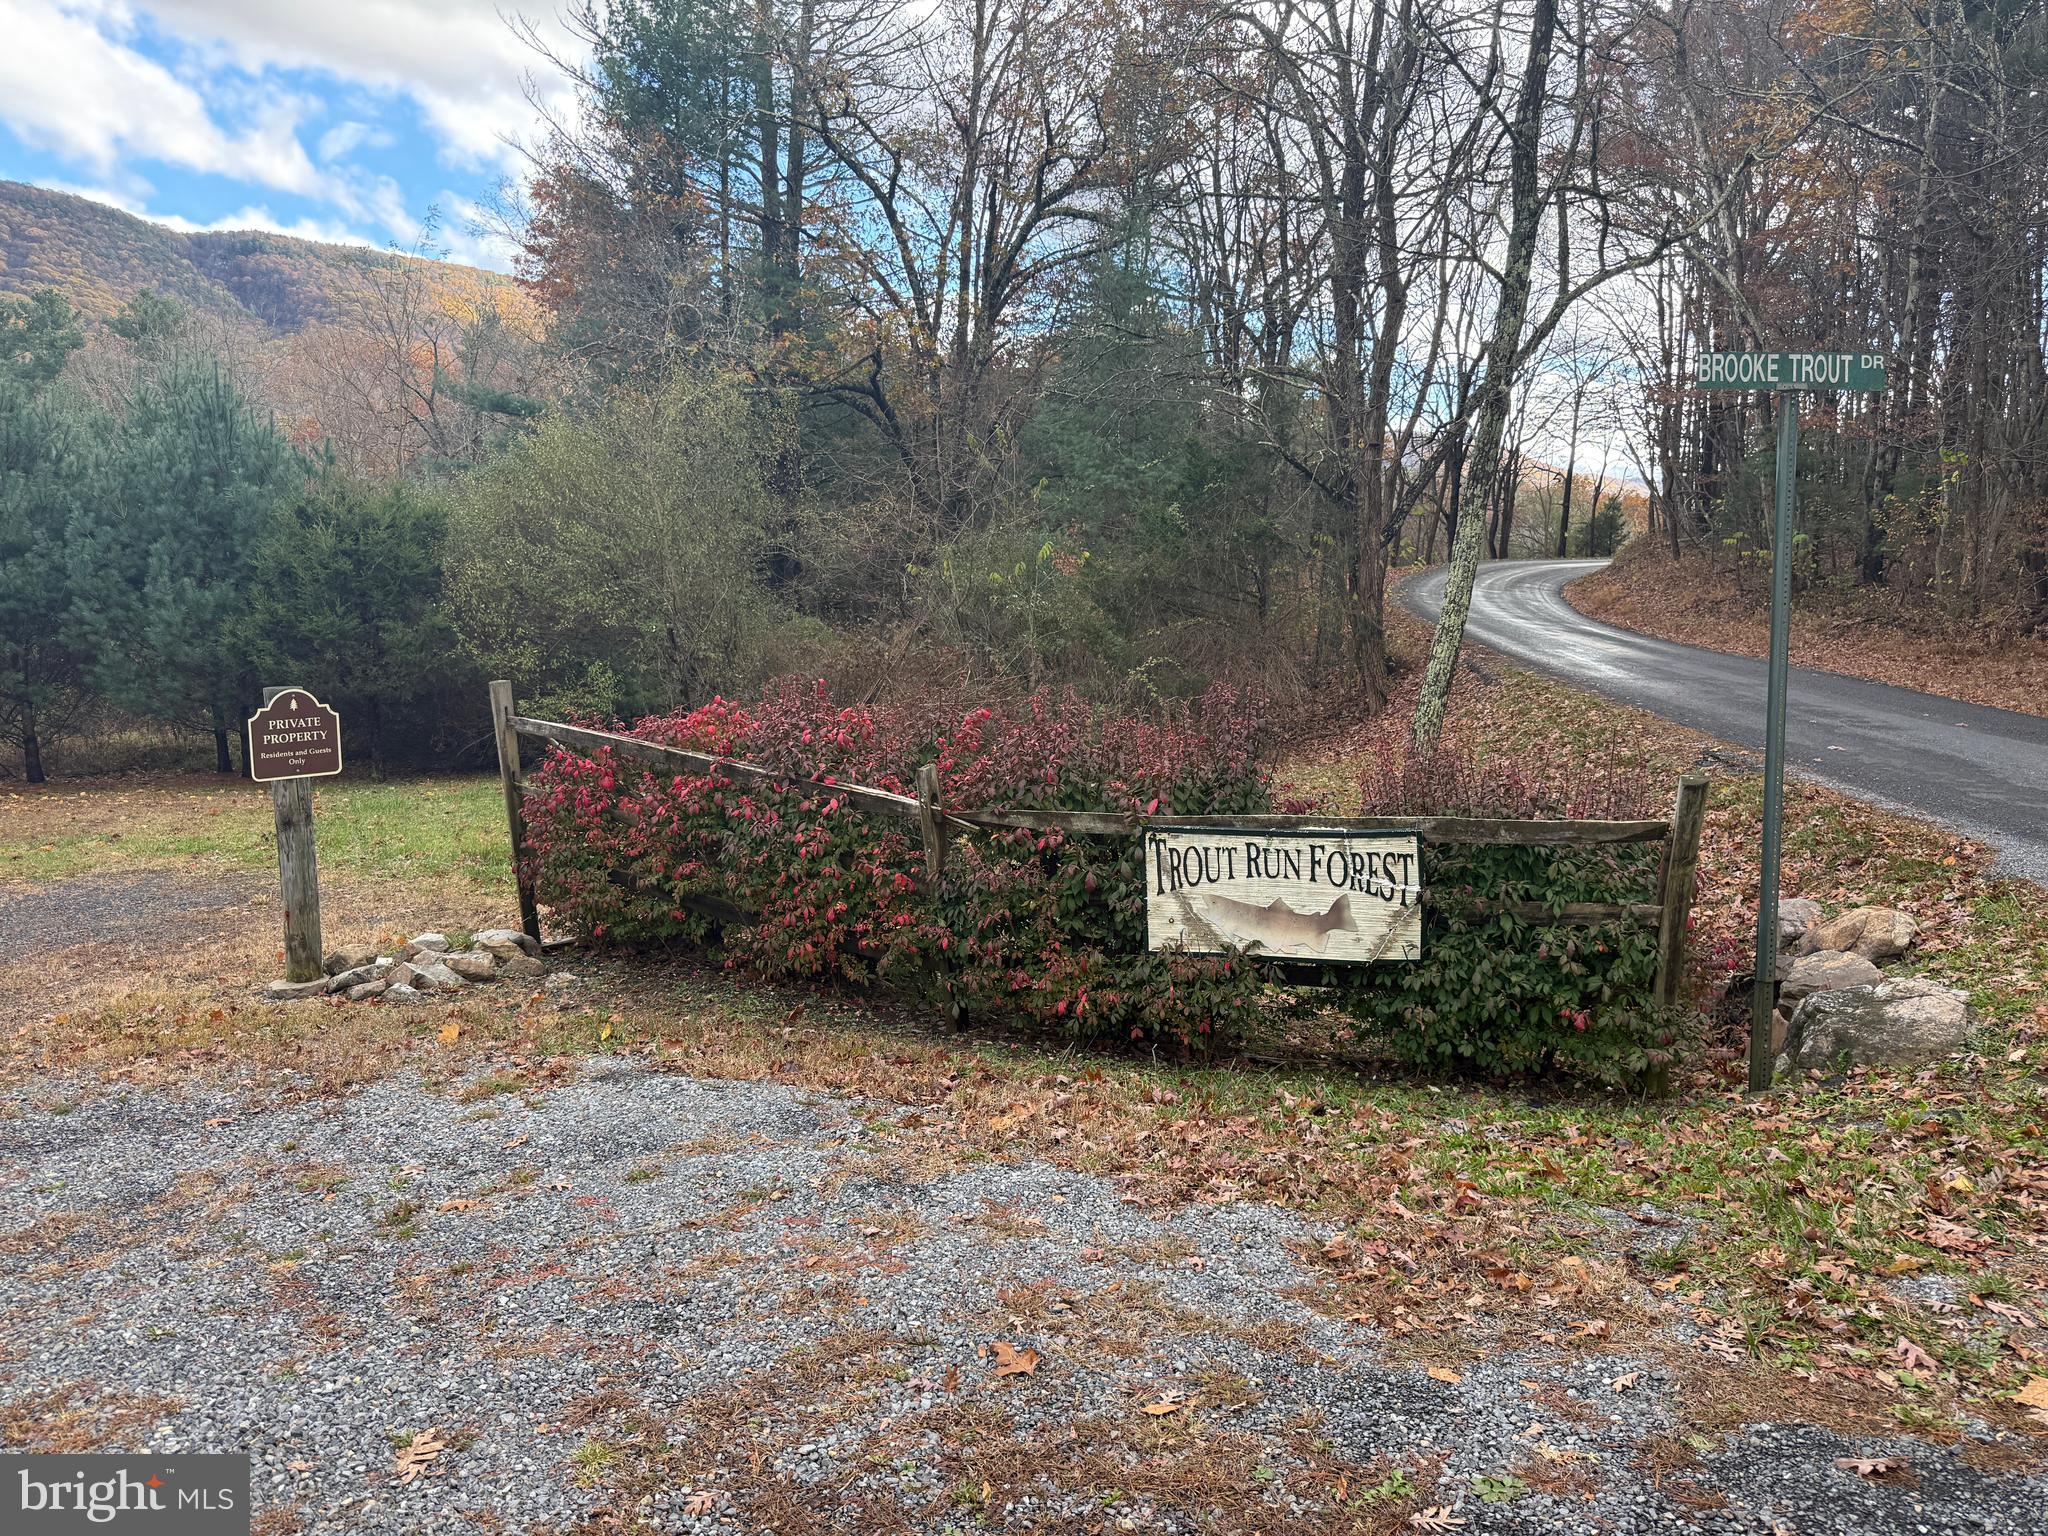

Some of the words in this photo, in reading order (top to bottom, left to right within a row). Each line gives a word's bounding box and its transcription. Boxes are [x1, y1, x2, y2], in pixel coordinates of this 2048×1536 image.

[1699, 353, 1779, 382] BROOKE
[1788, 354, 1853, 383] TROUT
[1861, 355, 1884, 369] DR
[268, 717, 321, 730] PRIVATE
[263, 730, 328, 745] PROPERTY
[260, 751, 294, 759] Residents
[309, 747, 332, 755] Guests
[288, 757, 306, 766] Only
[1150, 837, 1237, 896] TROUT
[1246, 842, 1301, 880] RUN
[1309, 844, 1414, 907] FOREST
